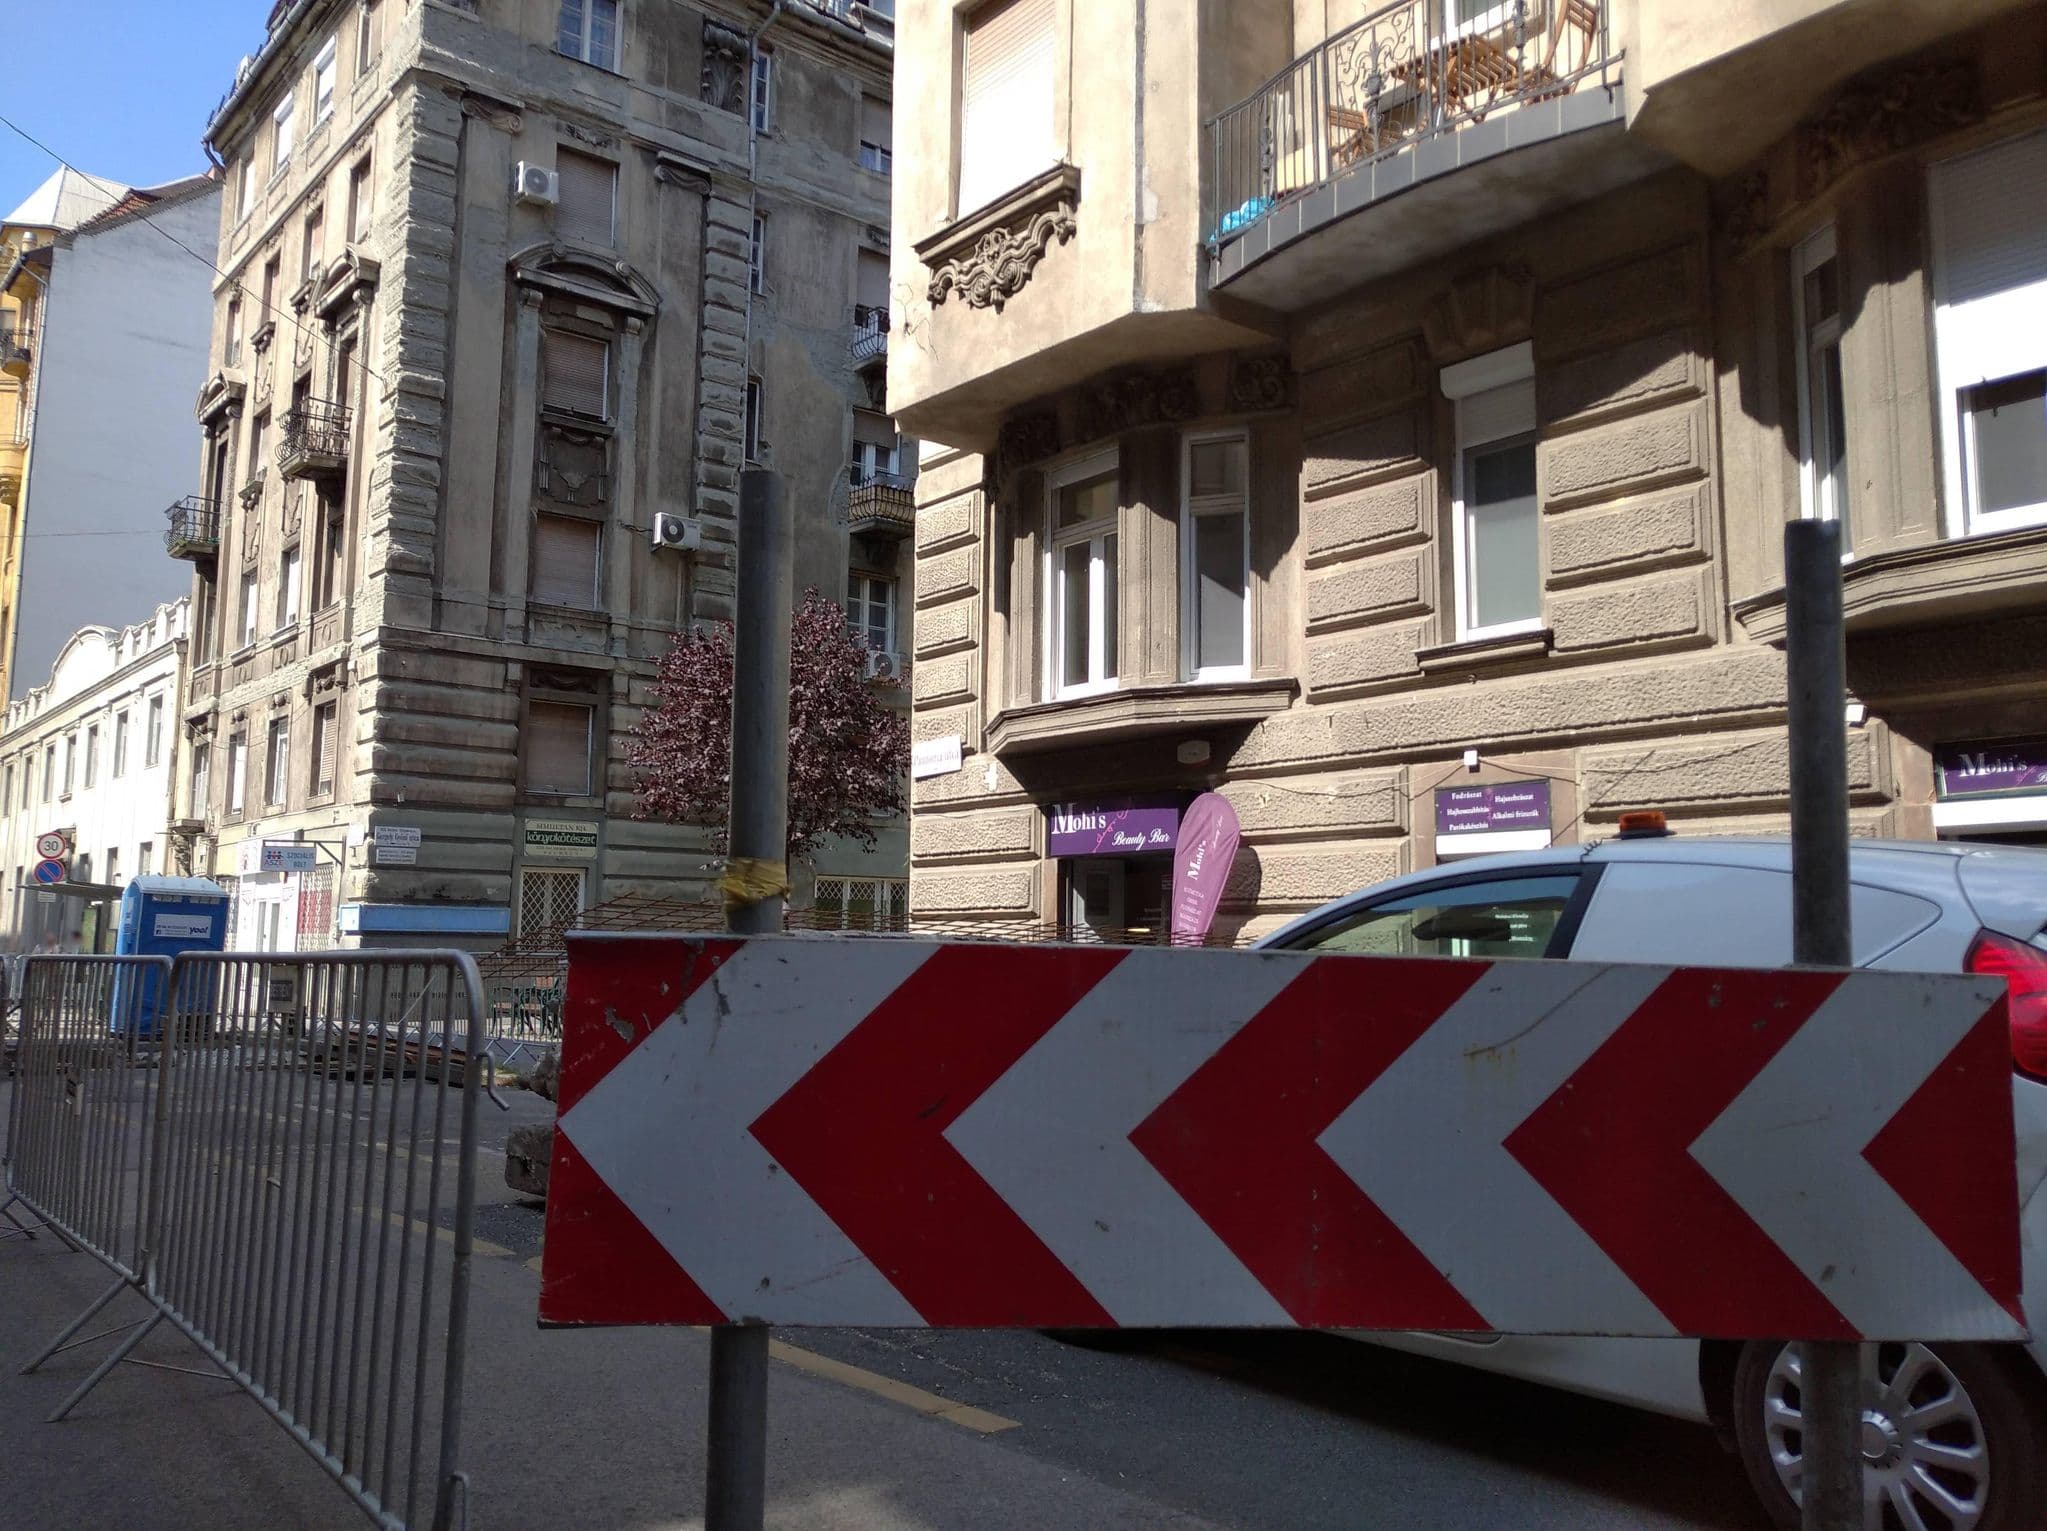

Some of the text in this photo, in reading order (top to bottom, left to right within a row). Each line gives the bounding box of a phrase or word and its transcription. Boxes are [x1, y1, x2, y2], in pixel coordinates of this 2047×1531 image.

[1958, 752, 2028, 778] Mohi's
[1051, 802, 1106, 834] Mohi's
[1492, 811, 1515, 819] Alkalmi
[44, 841, 59, 851] 30
[527, 831, 596, 844] könyvkötészet
[1112, 828, 1171, 851] Beauty Bar
